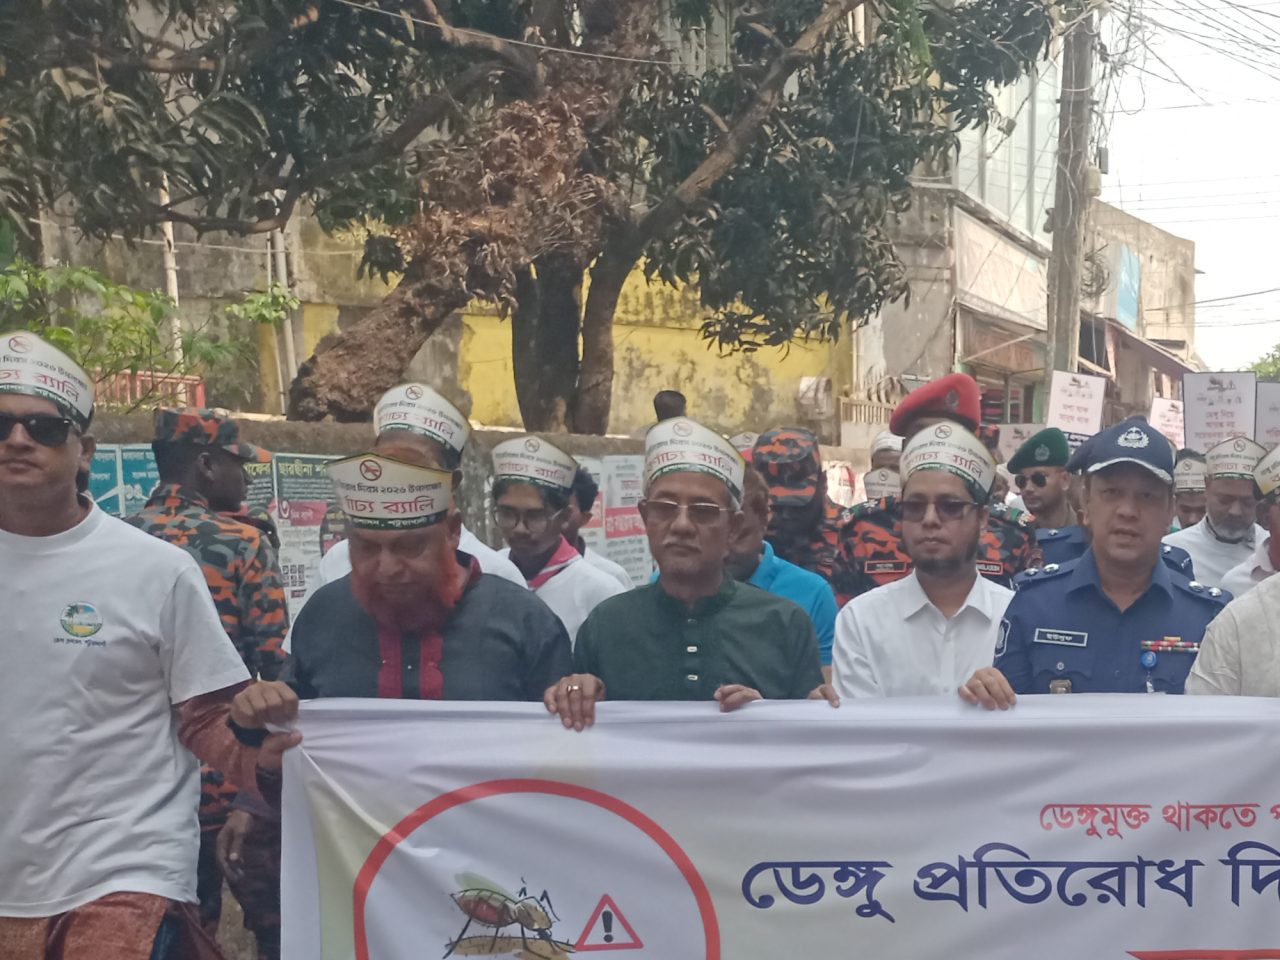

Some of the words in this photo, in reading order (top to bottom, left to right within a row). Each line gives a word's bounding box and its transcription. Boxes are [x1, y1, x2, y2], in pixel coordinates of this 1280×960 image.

[380, 495, 434, 513] র‍্যালি
[1040, 803, 1151, 838] ডেঙ্গুমুক্ত
[1163, 803, 1260, 829] থাকতে
[742, 861, 894, 923] ডেঙ্গু
[914, 843, 1205, 911] প্রতিরোধ
